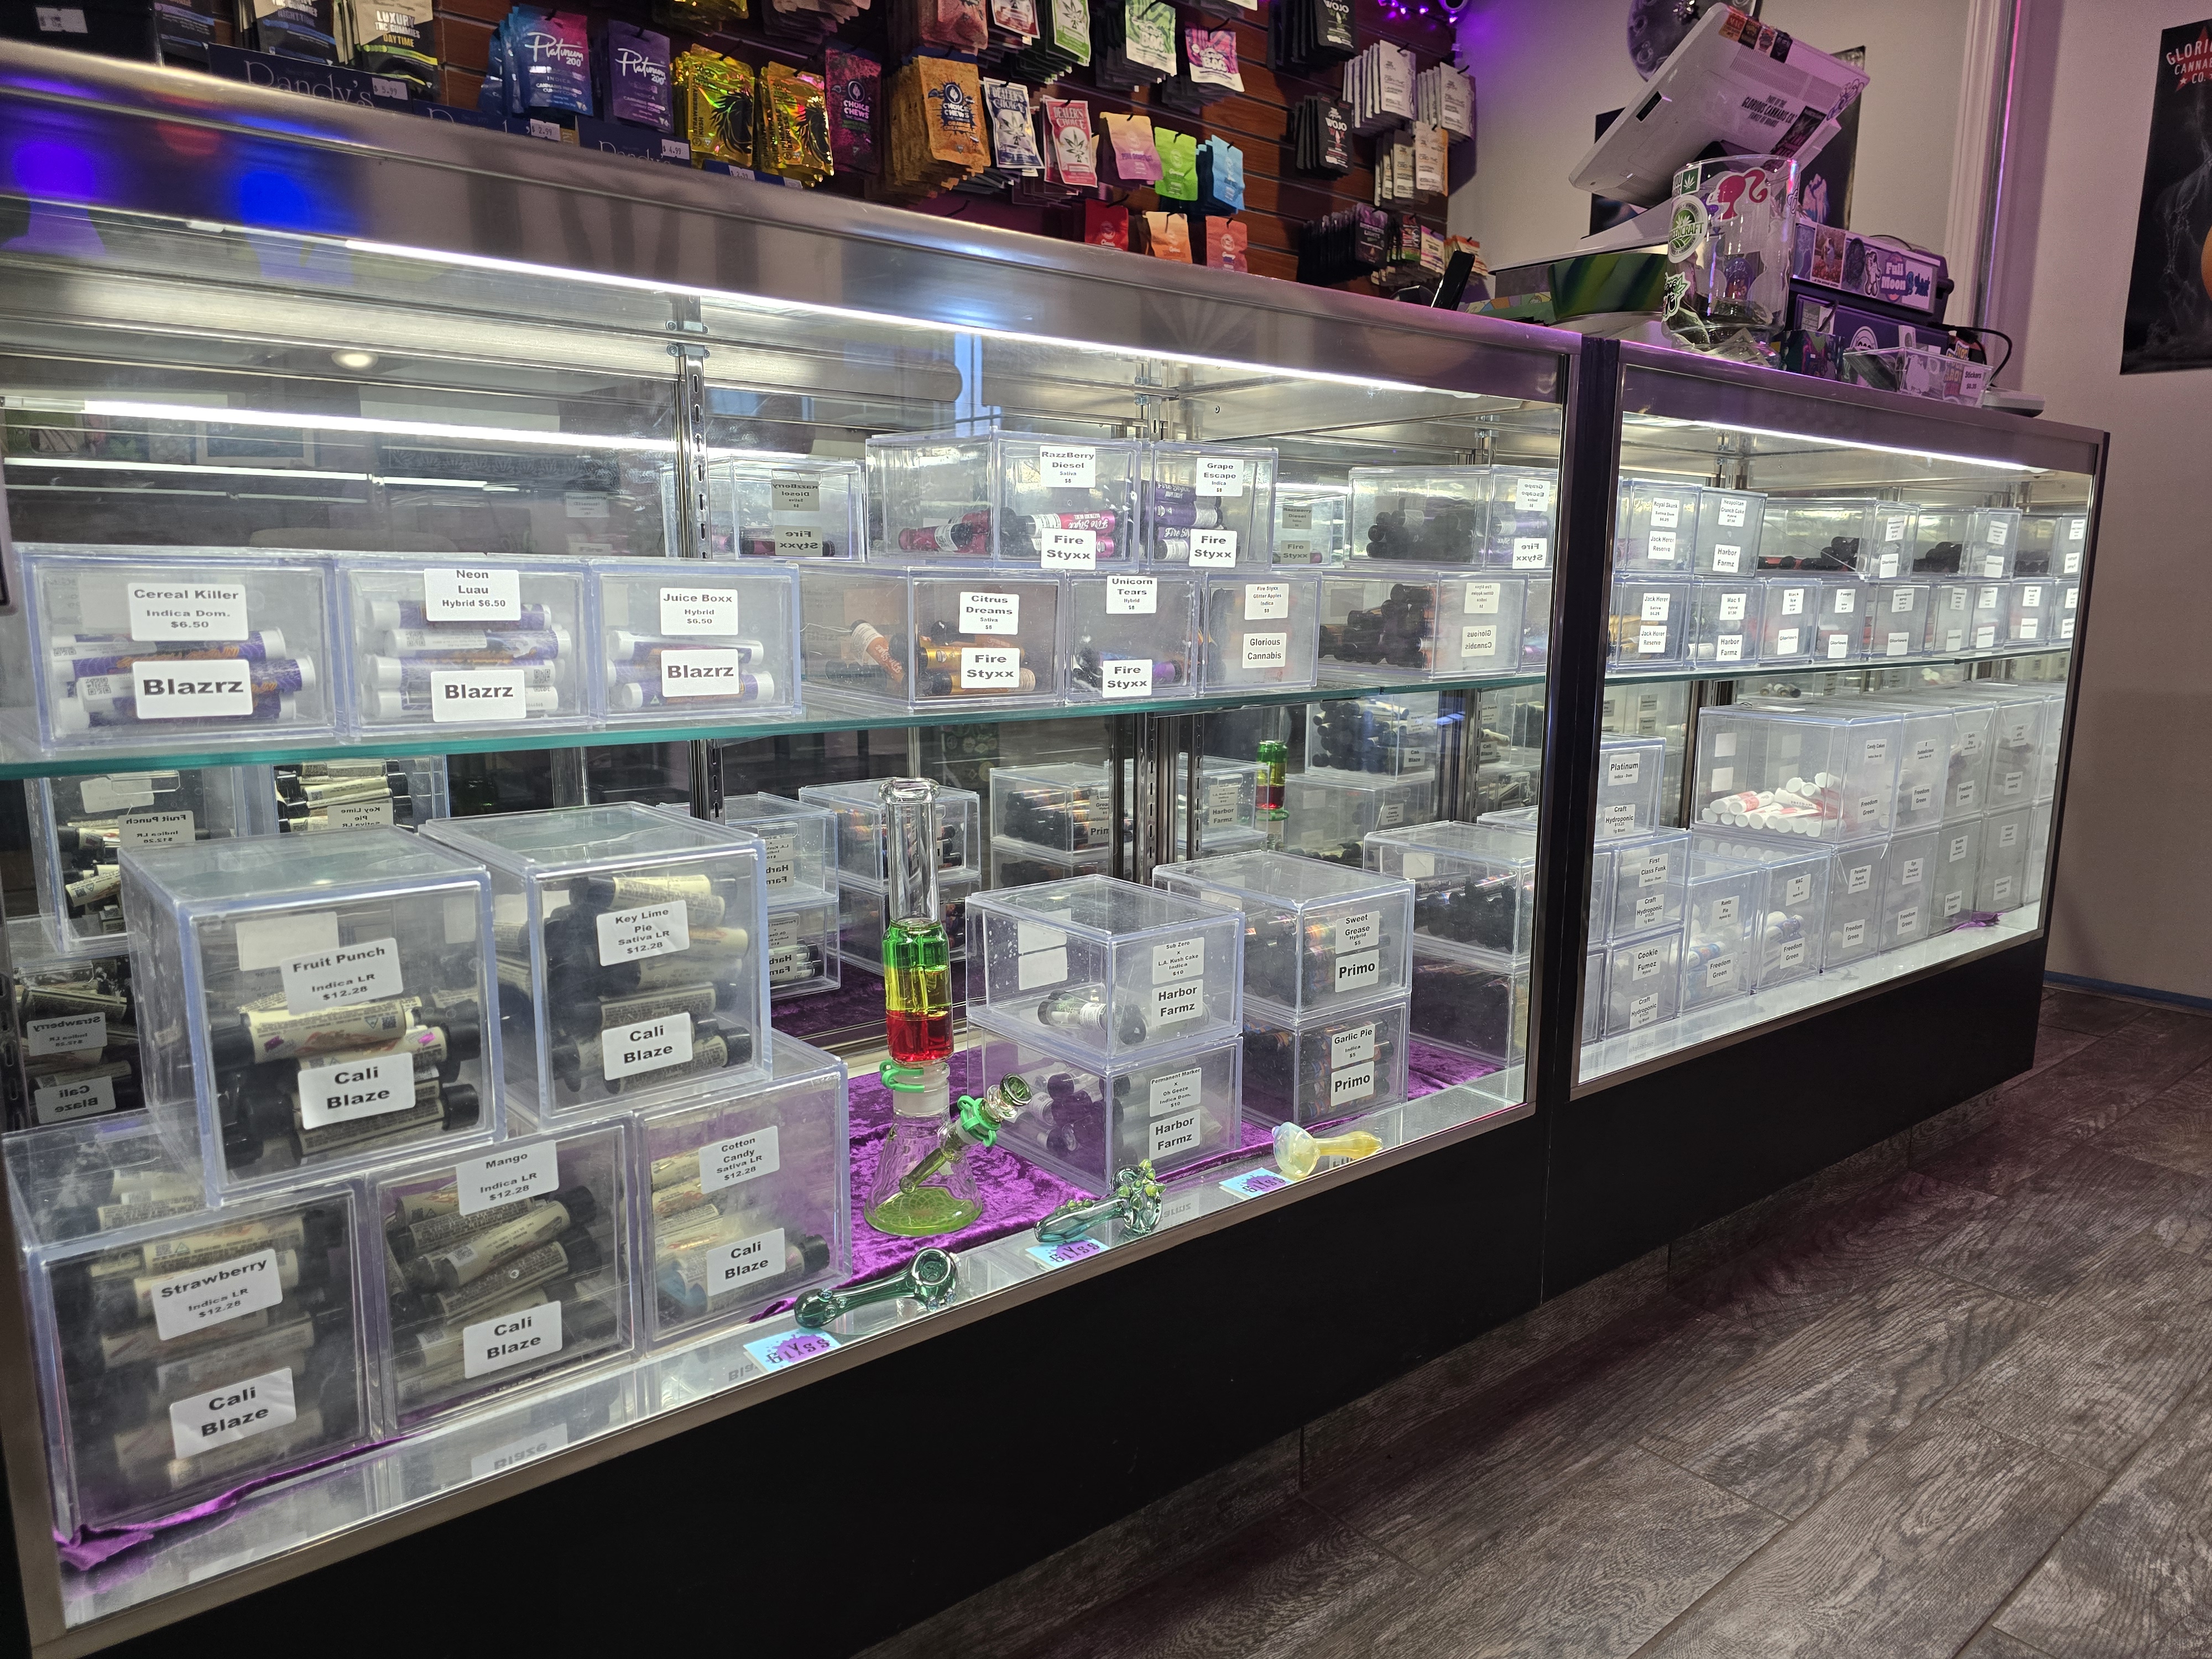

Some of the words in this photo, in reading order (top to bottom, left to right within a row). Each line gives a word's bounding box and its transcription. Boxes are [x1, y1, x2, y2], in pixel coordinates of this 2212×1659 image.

[376, 10, 415, 28] LUXURY
[383, 33, 415, 48] DAYTIME
[524, 32, 584, 64] Platinum
[566, 56, 582, 67] 200
[614, 48, 666, 77] Platinum
[651, 74, 665, 85] 200
[2191, 72, 2206, 85] CO.
[990, 87, 1024, 103] DEALER'S
[843, 99, 870, 113] CHOICE
[993, 97, 1026, 113] CHOICE
[843, 106, 870, 120] CHEWS
[1053, 106, 1084, 119] DEALER'S
[1056, 118, 1086, 130] CHOICE
[1885, 262, 1904, 275] Full
[1881, 277, 1906, 291] Moon
[1964, 370, 1983, 380] Stickers
[1041, 451, 1095, 461] RazzBerry
[1052, 461, 1084, 469] Diesel
[1054, 535, 1084, 545] Fire
[1201, 536, 1227, 544] Fire
[1046, 549, 1092, 561] Styxx
[1194, 549, 1232, 559] Styxx
[1717, 548, 1738, 557] Harbor
[456, 569, 489, 580] Neon
[134, 589, 189, 599] Cereal
[195, 589, 239, 599] Killer
[458, 585, 489, 595] Luau
[442, 598, 476, 608] Hybrid
[478, 599, 506, 608] $6.50
[663, 593, 698, 603] Juice
[702, 594, 733, 603] Boxx
[971, 594, 1009, 604] Citrus
[147, 609, 191, 618] Indica
[966, 606, 1013, 615] Dreams
[170, 620, 210, 629] $6.50
[1249, 637, 1281, 647] Glorious
[974, 654, 1007, 664] Fire
[1248, 651, 1282, 661] Cannabis
[667, 664, 734, 679] Blazrz
[967, 669, 1014, 680] Styxx
[1114, 666, 1142, 675] Fire
[143, 678, 244, 696] Blazrz
[1107, 679, 1148, 690] Styxx
[444, 684, 514, 700] Blazrz
[1610, 761, 1639, 772] Platinum
[1861, 799, 1878, 807] Freedom
[1605, 813, 1634, 825] Hydroponic
[1641, 867, 1655, 875] Class
[1655, 864, 1667, 873] Funk
[615, 914, 638, 925] Key
[641, 908, 669, 920] Lime
[1636, 904, 1663, 916] Hydroponic
[1345, 914, 1369, 925] Sweet
[634, 924, 653, 933] Pie
[1344, 926, 1371, 936] Grease
[1845, 924, 1863, 932] Freedom
[618, 935, 653, 946] Sativa
[655, 930, 670, 939] LR
[627, 941, 663, 955] $12.28
[1637, 948, 1658, 960] Cookie
[1783, 943, 1803, 953] Freedom
[293, 957, 332, 973] Fruit
[336, 946, 385, 965] Punch
[1169, 957, 1185, 965] Kush
[1185, 953, 1199, 962] Cake
[1786, 952, 1799, 961] Green
[1168, 962, 1188, 971] Indica
[1338, 961, 1376, 979] Primo
[1637, 961, 1657, 972] Fumez
[1710, 958, 1731, 970] Freedom
[1713, 969, 1728, 979] Green
[311, 979, 353, 993] Indica
[357, 974, 375, 984] LR
[322, 985, 368, 1001] $12.28
[1157, 985, 1198, 1002] Harbor
[1639, 996, 1651, 1005] Craft
[1160, 1002, 1196, 1018] Farmz
[1631, 1003, 1657, 1017] Hydroponic
[629, 1026, 664, 1042] Cali
[1334, 1032, 1359, 1045] Garlic
[1360, 1027, 1373, 1038] Pie
[623, 1044, 674, 1065] Blaze
[334, 1066, 379, 1085] Cali
[1150, 1073, 1181, 1086] Permanent
[1181, 1068, 1201, 1078] Marker
[1334, 1073, 1371, 1093] Primo
[1171, 1086, 1190, 1095] Geeze
[326, 1088, 391, 1110] Blaze
[1155, 1117, 1195, 1136] Harbor
[721, 1136, 756, 1153] Cotton
[1157, 1133, 1193, 1151] Farmz
[485, 1153, 529, 1170] Mango
[723, 1149, 755, 1164] Candy
[716, 1160, 747, 1175] Sativa
[749, 1155, 763, 1164] LR
[724, 1166, 757, 1181] $12.28
[480, 1178, 518, 1193] Indica
[521, 1172, 538, 1183] LR
[489, 1185, 530, 1202] $12.28
[730, 1241, 761, 1260] Cali
[724, 1259, 769, 1280] Blaze
[161, 1258, 268, 1299] Strawberry
[187, 1295, 228, 1312] Indica
[232, 1287, 249, 1298] LR
[198, 1300, 242, 1319] $12.28
[493, 1316, 532, 1337] Cali
[486, 1336, 541, 1360] Blaze
[209, 1386, 257, 1411] Cali
[201, 1407, 269, 1438] Blaze
